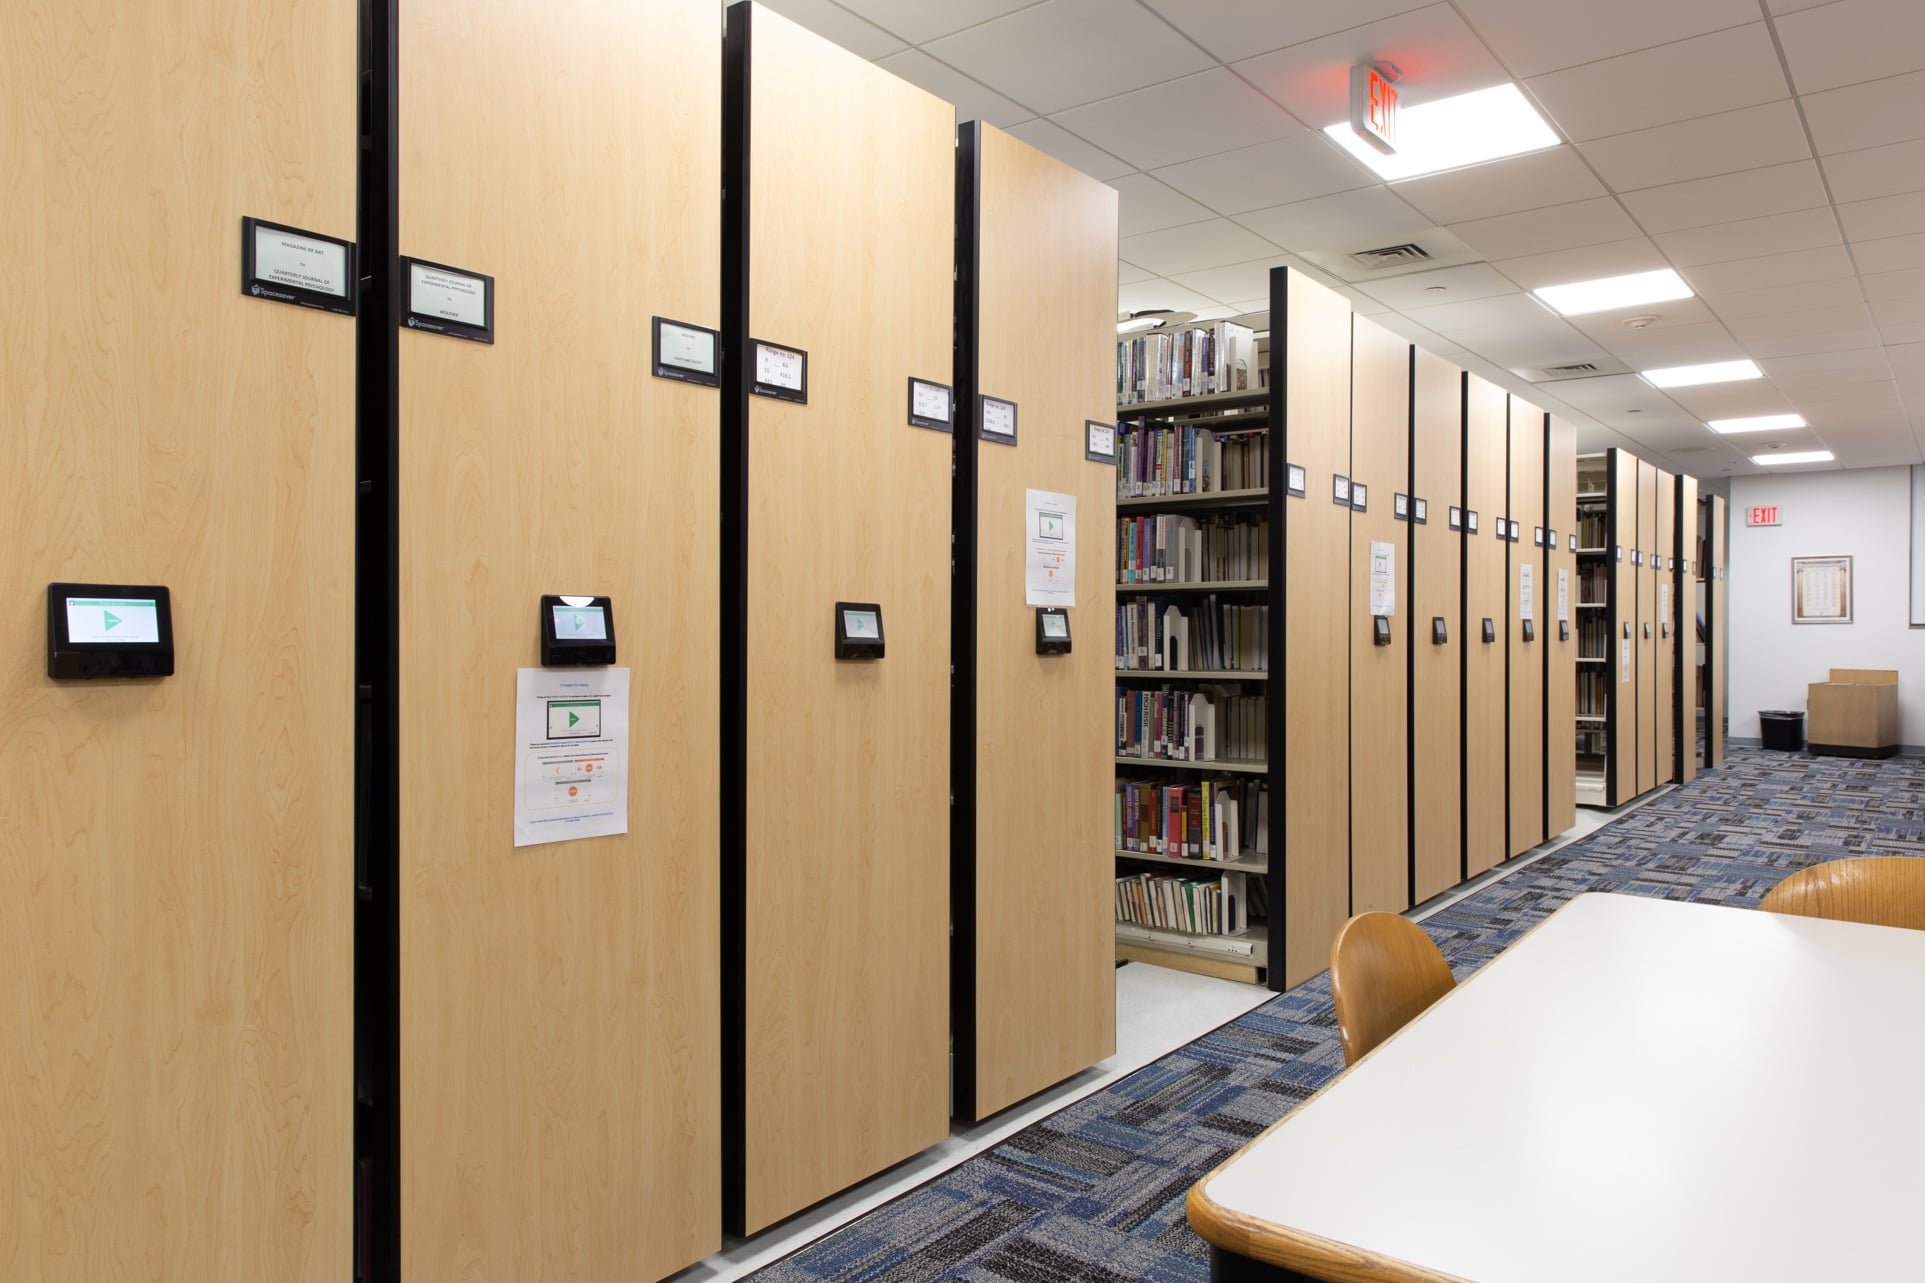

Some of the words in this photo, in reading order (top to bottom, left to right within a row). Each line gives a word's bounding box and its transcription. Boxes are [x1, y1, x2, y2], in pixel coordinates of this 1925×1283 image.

[1370, 71, 1398, 144] EXIT
[281, 241, 307, 252] MAGAZINE
[268, 274, 304, 286] EXPERIMENTAL
[305, 282, 335, 293] PSYCHOLOGY
[273, 268, 301, 279] QUARTERLY
[302, 275, 323, 284] JOURNAL
[260, 287, 295, 300] Spacesaver
[1753, 506, 1778, 524] EXIT
